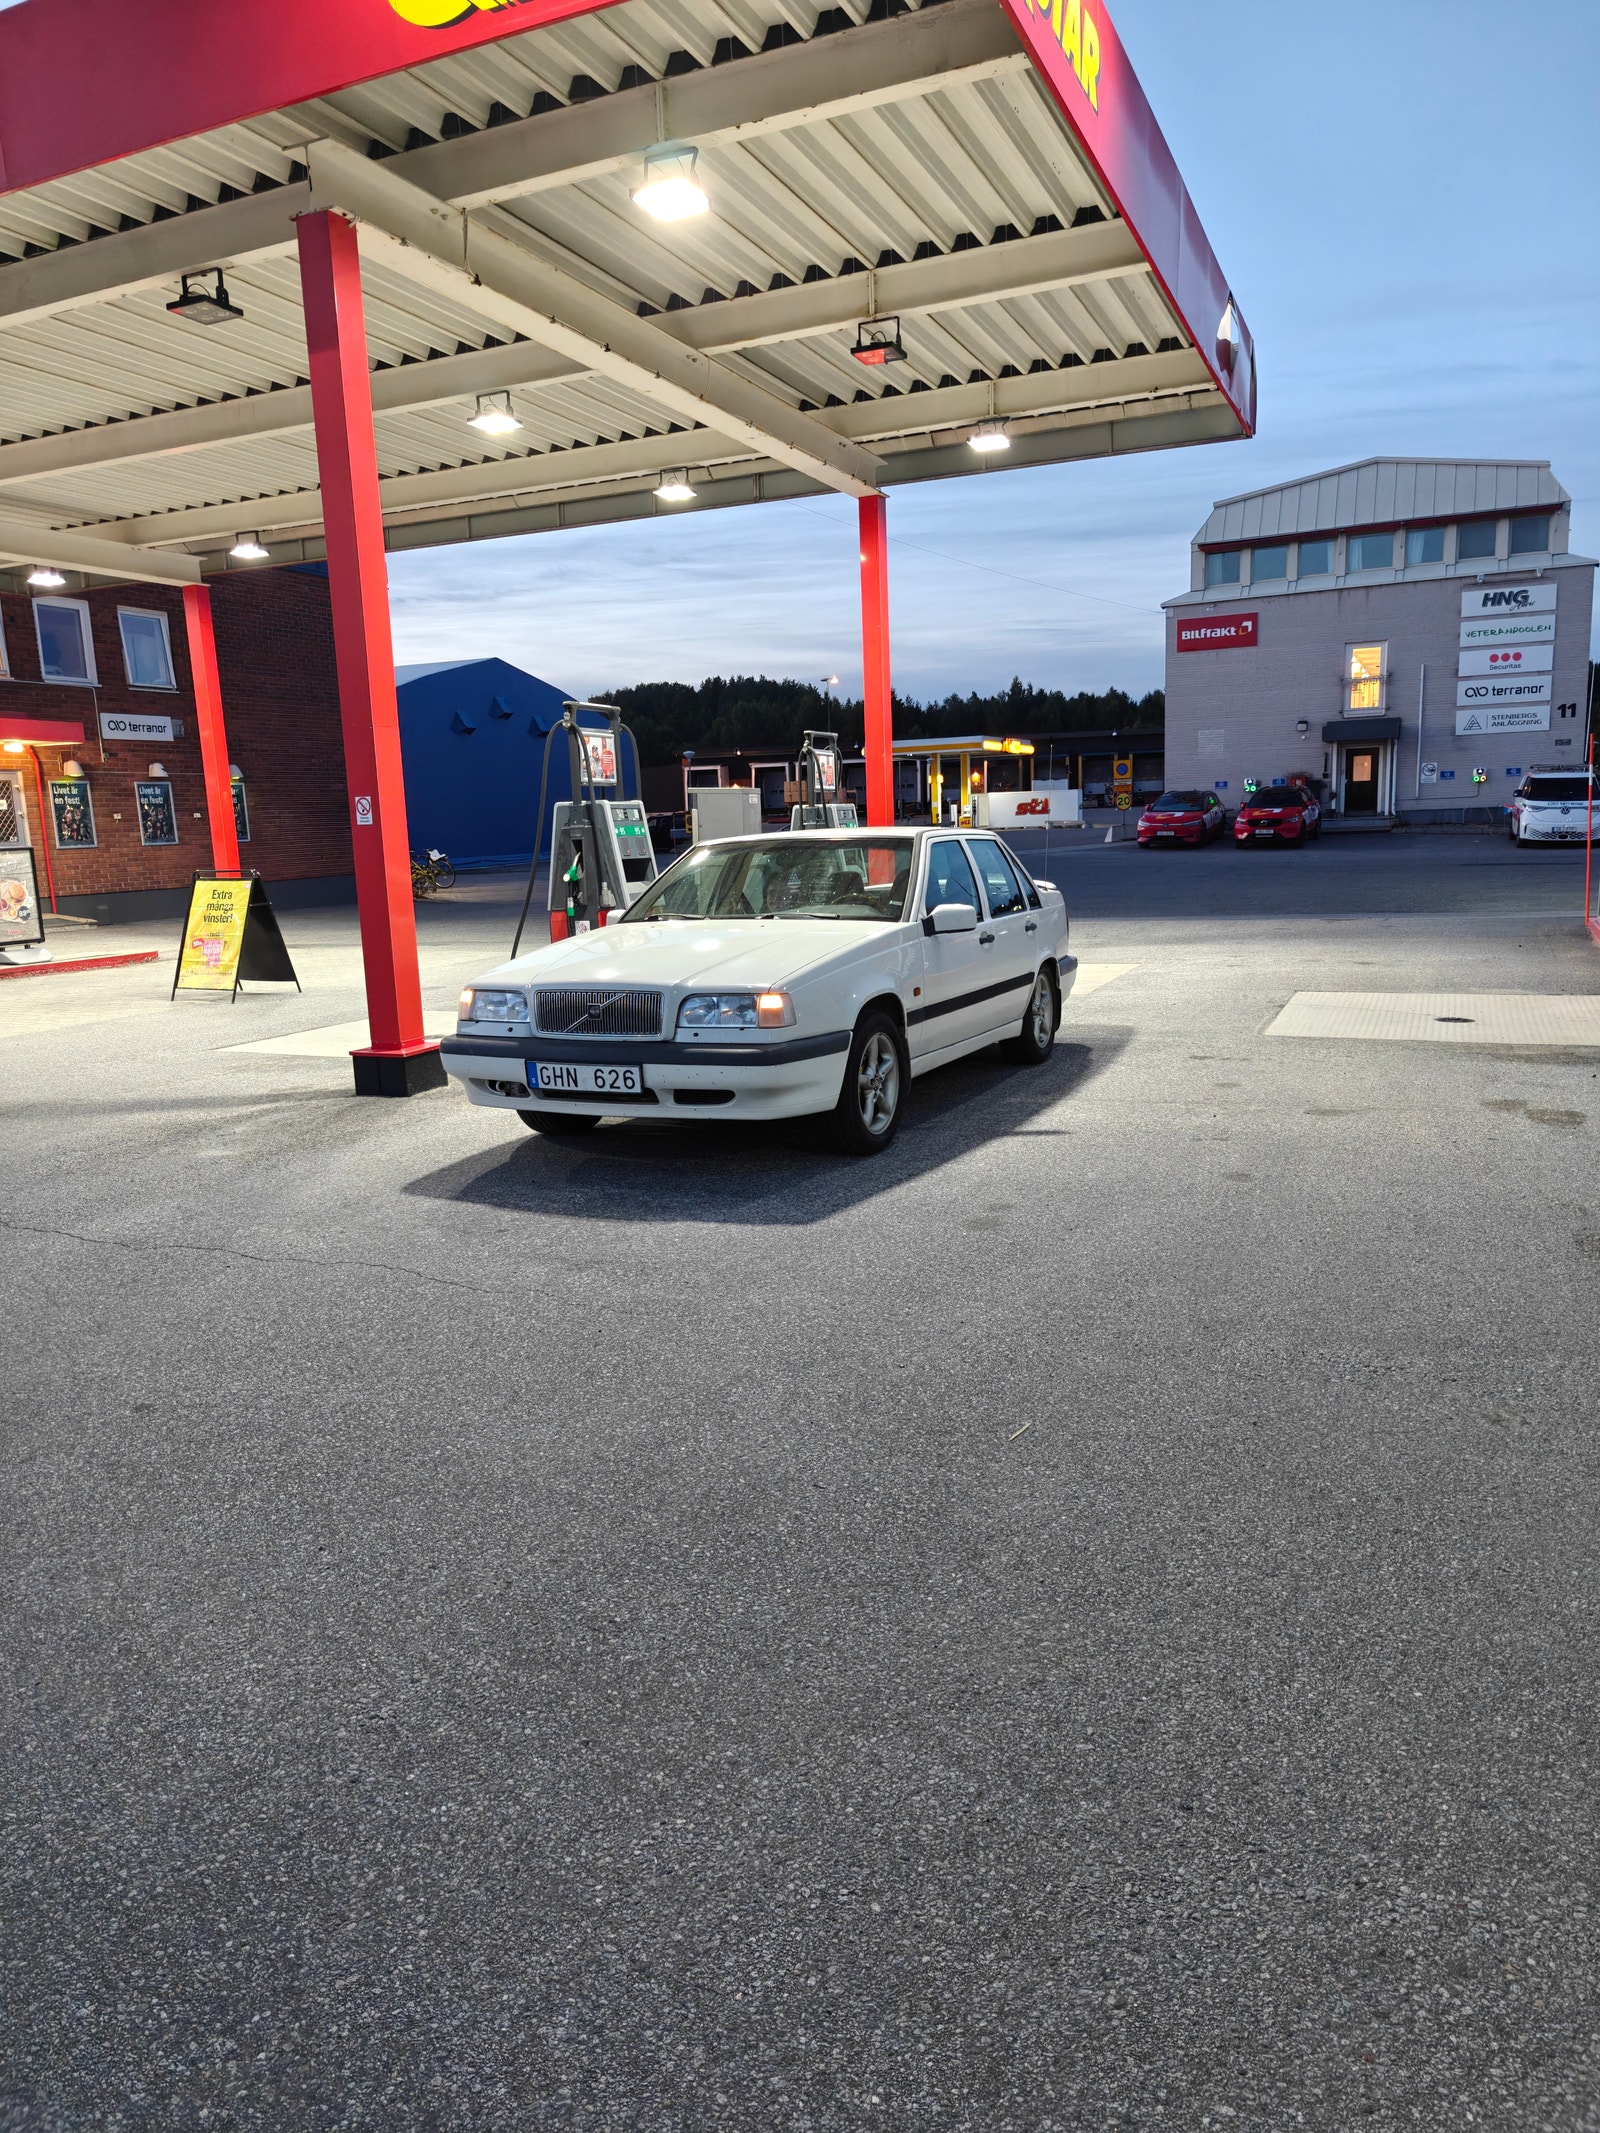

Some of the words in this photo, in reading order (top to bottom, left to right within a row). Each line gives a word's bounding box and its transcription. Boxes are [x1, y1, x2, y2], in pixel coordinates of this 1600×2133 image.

[1482, 590, 1530, 607] HNG
[1465, 624, 1551, 638] VETERANPOOLEN
[1489, 663, 1522, 671] Securitas
[1492, 685, 1545, 696] terranor
[1556, 703, 1577, 718] 11
[1491, 713, 1538, 721] STENBERGS
[128, 721, 168, 734] terranor
[53, 785, 69, 795] Livet
[139, 786, 154, 795] Livet
[55, 796, 64, 805] en
[1117, 796, 1130, 806] 20
[211, 889, 233, 900] Extra
[206, 901, 234, 914] många
[203, 913, 233, 923] vinster!
[540, 1066, 579, 1088] GHN
[594, 1068, 636, 1090] 626
